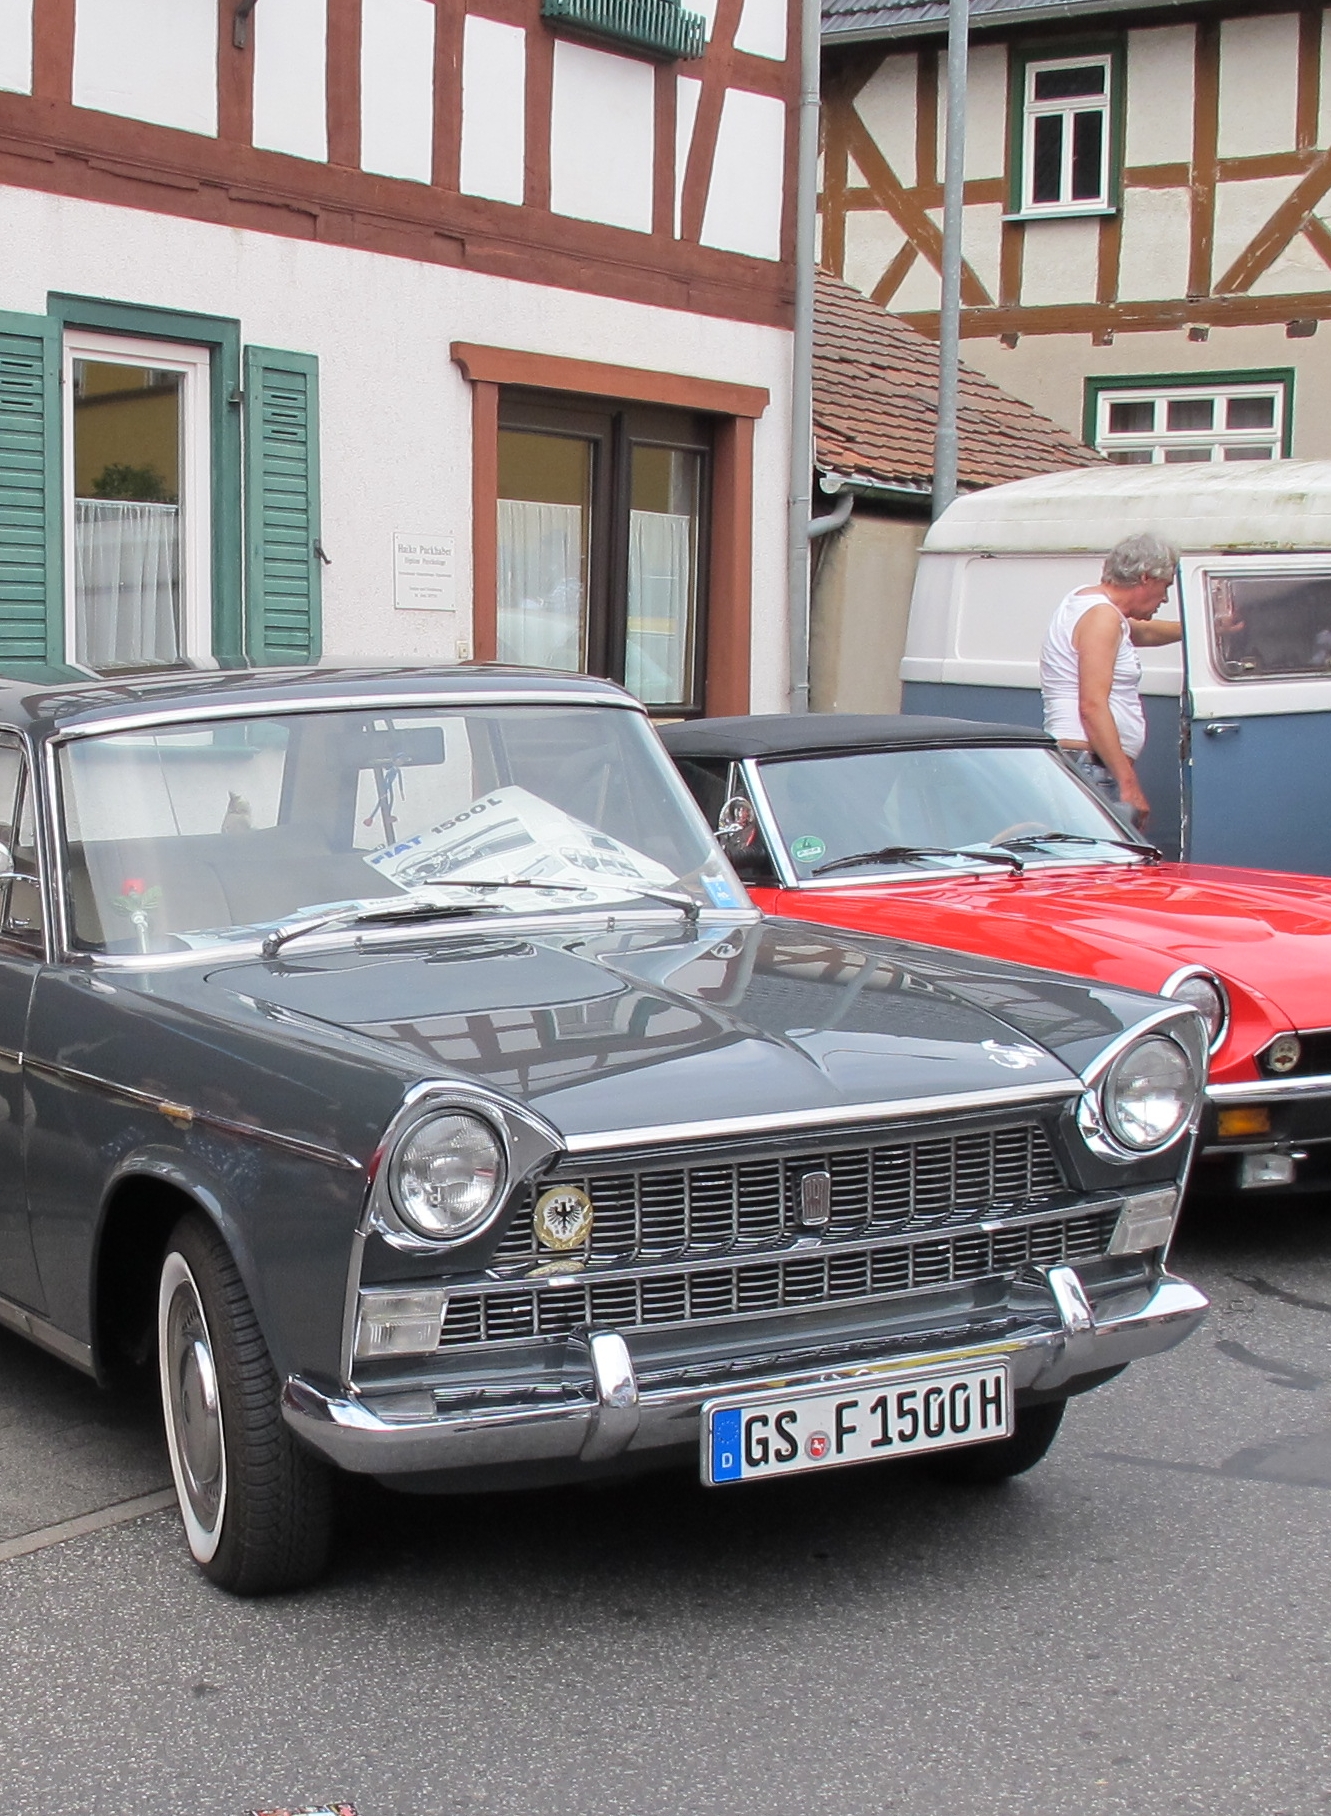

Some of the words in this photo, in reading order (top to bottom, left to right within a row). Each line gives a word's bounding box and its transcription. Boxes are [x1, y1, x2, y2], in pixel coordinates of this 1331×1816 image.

[370, 835, 422, 865] FIAT
[430, 803, 487, 835] 1500
[720, 1452, 734, 1469] D
[744, 1409, 799, 1467] GS
